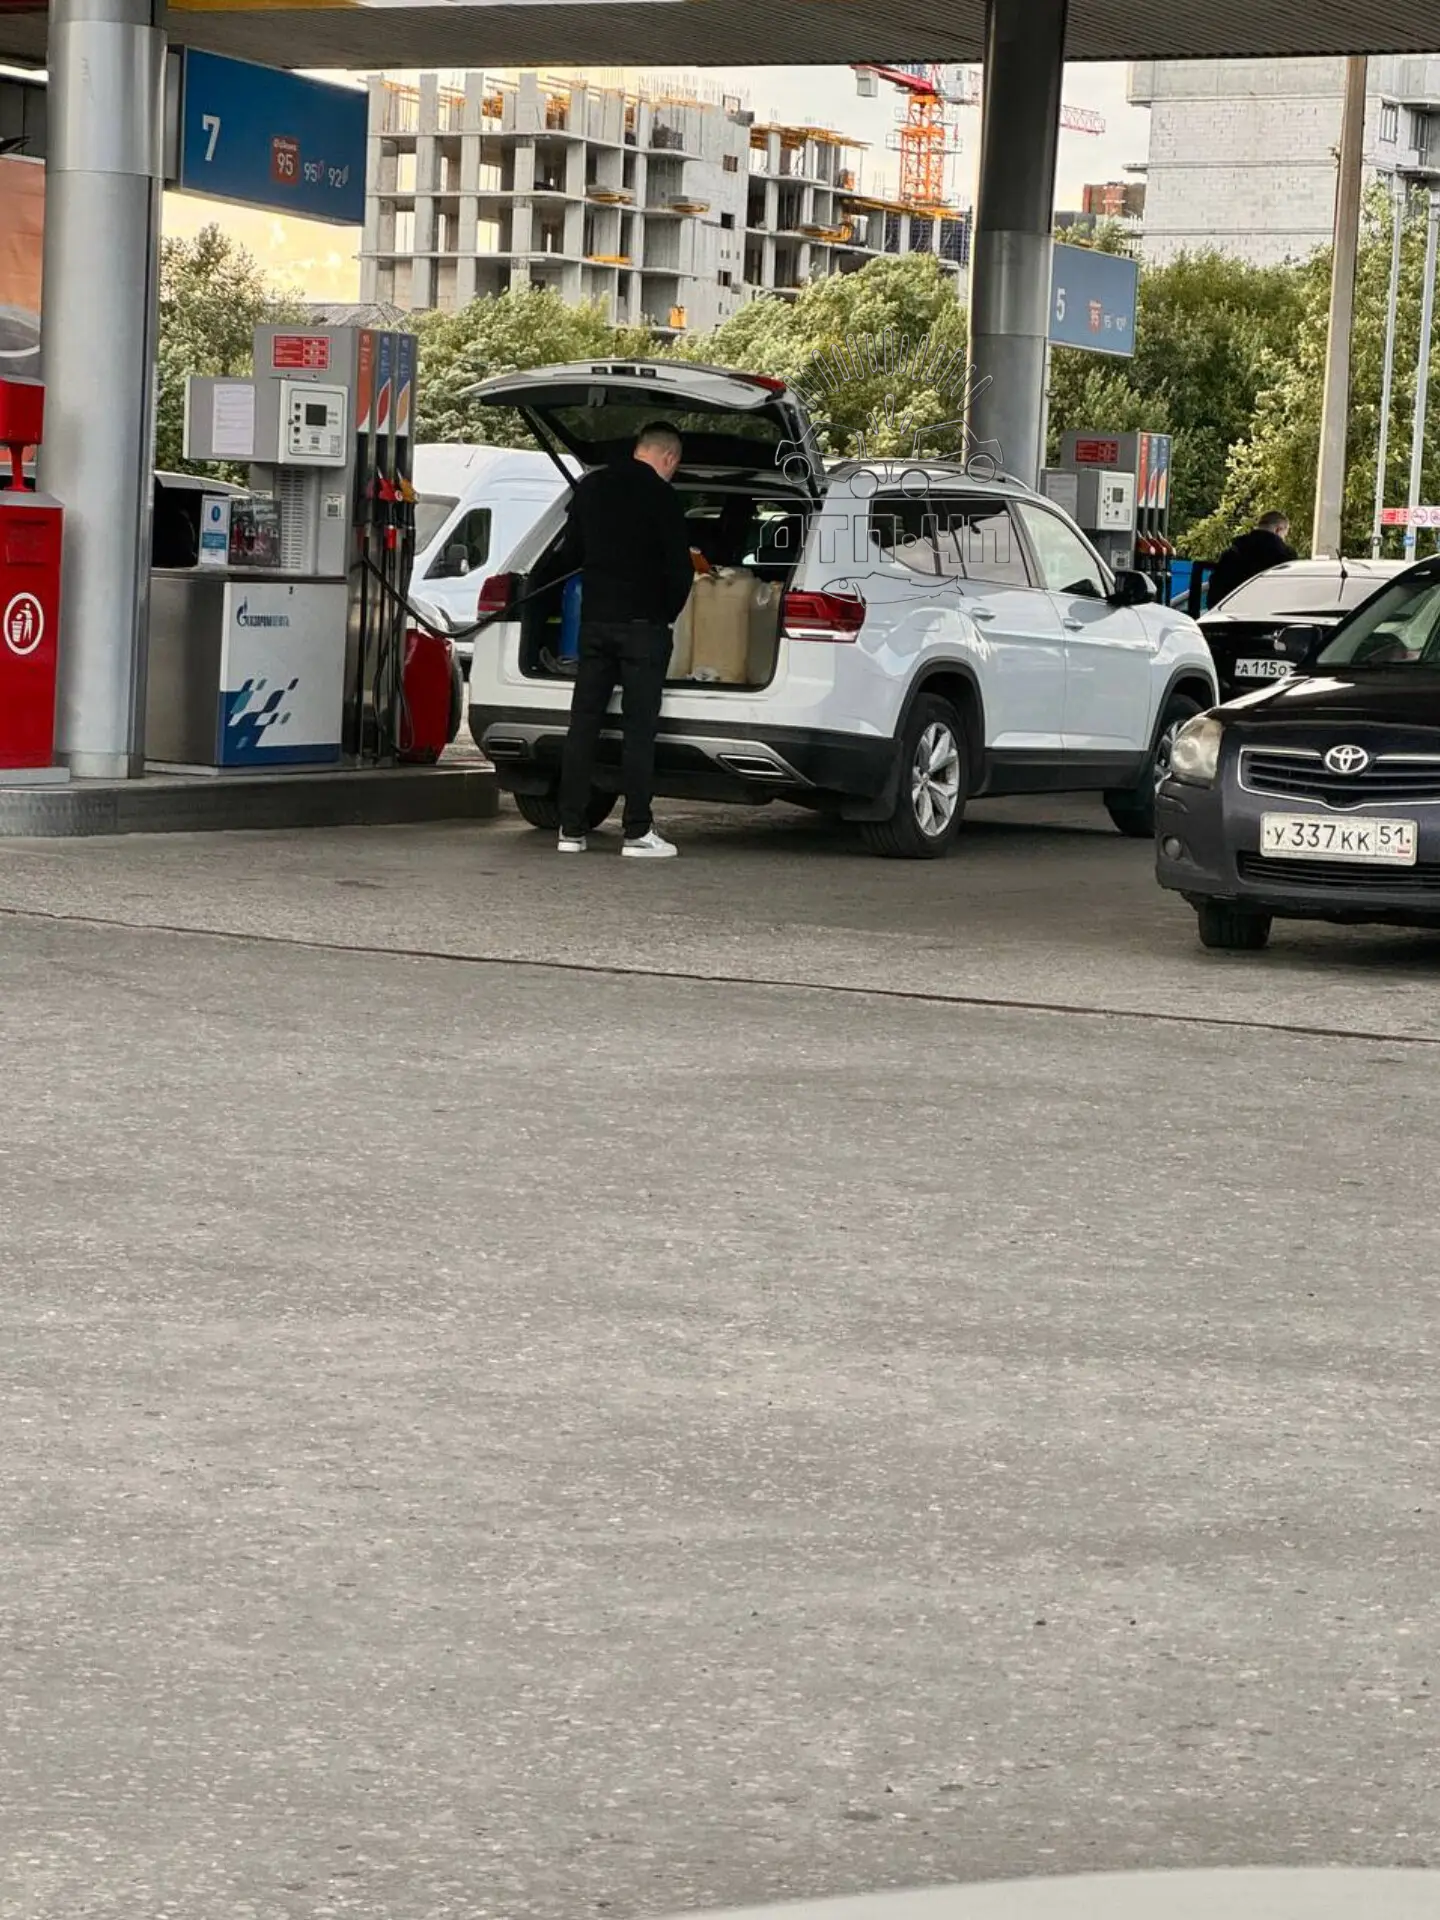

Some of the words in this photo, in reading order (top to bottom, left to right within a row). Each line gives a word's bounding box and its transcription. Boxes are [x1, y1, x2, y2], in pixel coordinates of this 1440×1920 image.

[202, 114, 221, 161] 7
[277, 153, 294, 176] 95
[304, 162, 318, 182] 95
[328, 167, 341, 188] 92
[1056, 288, 1066, 322] 5
